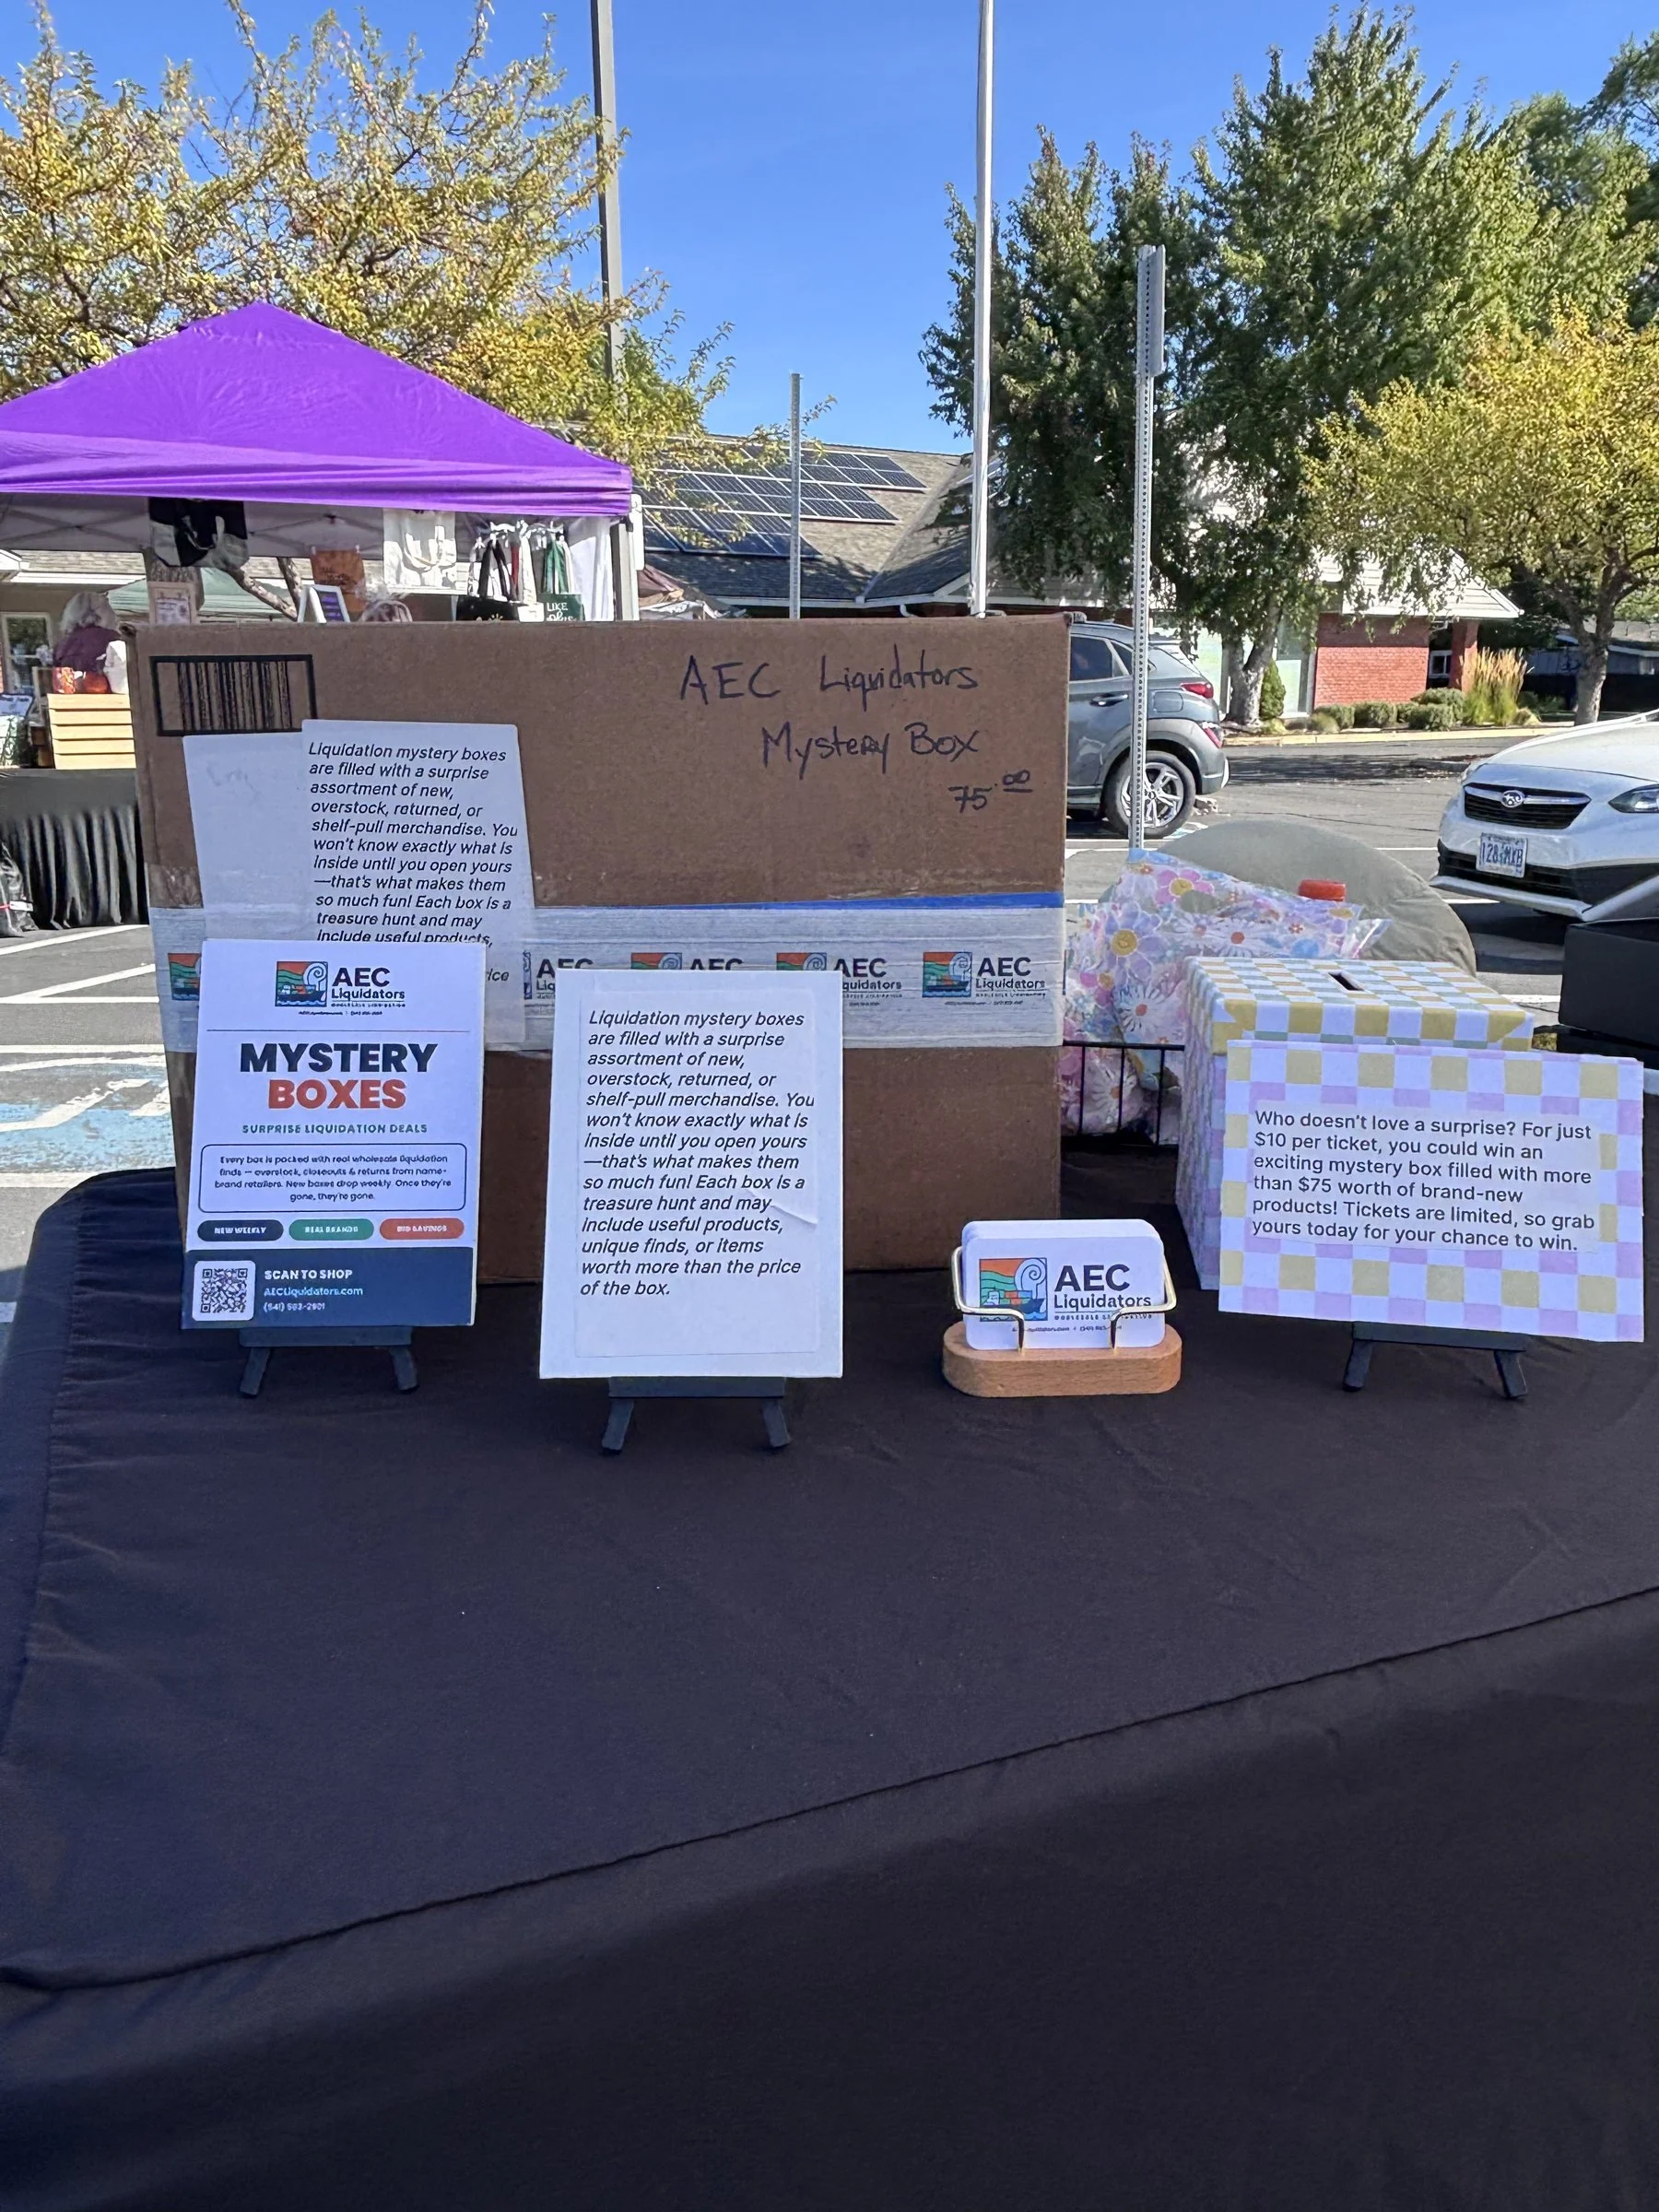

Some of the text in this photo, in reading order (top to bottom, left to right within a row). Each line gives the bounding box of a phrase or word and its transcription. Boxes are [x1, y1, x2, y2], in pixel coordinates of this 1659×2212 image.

[680, 644, 978, 712] AEC Liquidators
[309, 742, 507, 762] Liquidation mystery boxes
[761, 721, 978, 780] Mystery Box
[310, 762, 488, 781] are filled with a surprise
[311, 783, 454, 799] assortment of new,
[312, 801, 483, 819] overstock, returned, or
[312, 819, 518, 837] shelf-pull merchandise. You
[488, 968, 510, 982] ice
[834, 958, 887, 978] AEC
[977, 958, 1031, 976] AEC
[332, 968, 390, 986] AEC
[842, 980, 902, 991] quidators
[976, 979, 1045, 990] Liquidators
[331, 988, 406, 1002] Liquidators
[590, 1010, 805, 1029] Liquidation mystery boxes
[589, 1031, 784, 1049] are filled with a surprise
[241, 1042, 438, 1072] MYSTERY
[588, 1052, 745, 1068] assortment of new,
[587, 1072, 776, 1088] overstock, returned, or
[268, 1079, 406, 1109] BOXES
[586, 1092, 815, 1109] shelf-pull merchandise. You
[242, 1124, 427, 1134] SURPRISE LIQUIDATION DEALS
[587, 1113, 807, 1130] won't know exactly what is
[1254, 1111, 1591, 1142] Who doesn't love a surprise? For just
[584, 1133, 807, 1151] inside until you open yours
[1254, 1133, 1543, 1159] $10 per ticket, you could win an
[1253, 1156, 1591, 1183] exciting mystery box filled with more
[336, 1179, 359, 1190] drop
[395, 1179, 418, 1187] Once
[583, 1175, 805, 1189] so much fun! Each box is a
[1253, 1176, 1523, 1203] than $75 worth of brand-new
[584, 1195, 771, 1213] treasure hunt and may
[1253, 1198, 1594, 1231] products! Tickets are limited, so grab
[582, 1217, 782, 1234] include useful products,
[1253, 1220, 1577, 1251] yours today for your chance to win.
[582, 1238, 763, 1256] unique finds, or items
[265, 1269, 353, 1279] SCAN TO SHOP
[582, 1259, 801, 1277] worth more than the price
[1054, 1265, 1130, 1291] AEC
[581, 1280, 670, 1295] of the box.
[1054, 1294, 1151, 1312] Liquidators
